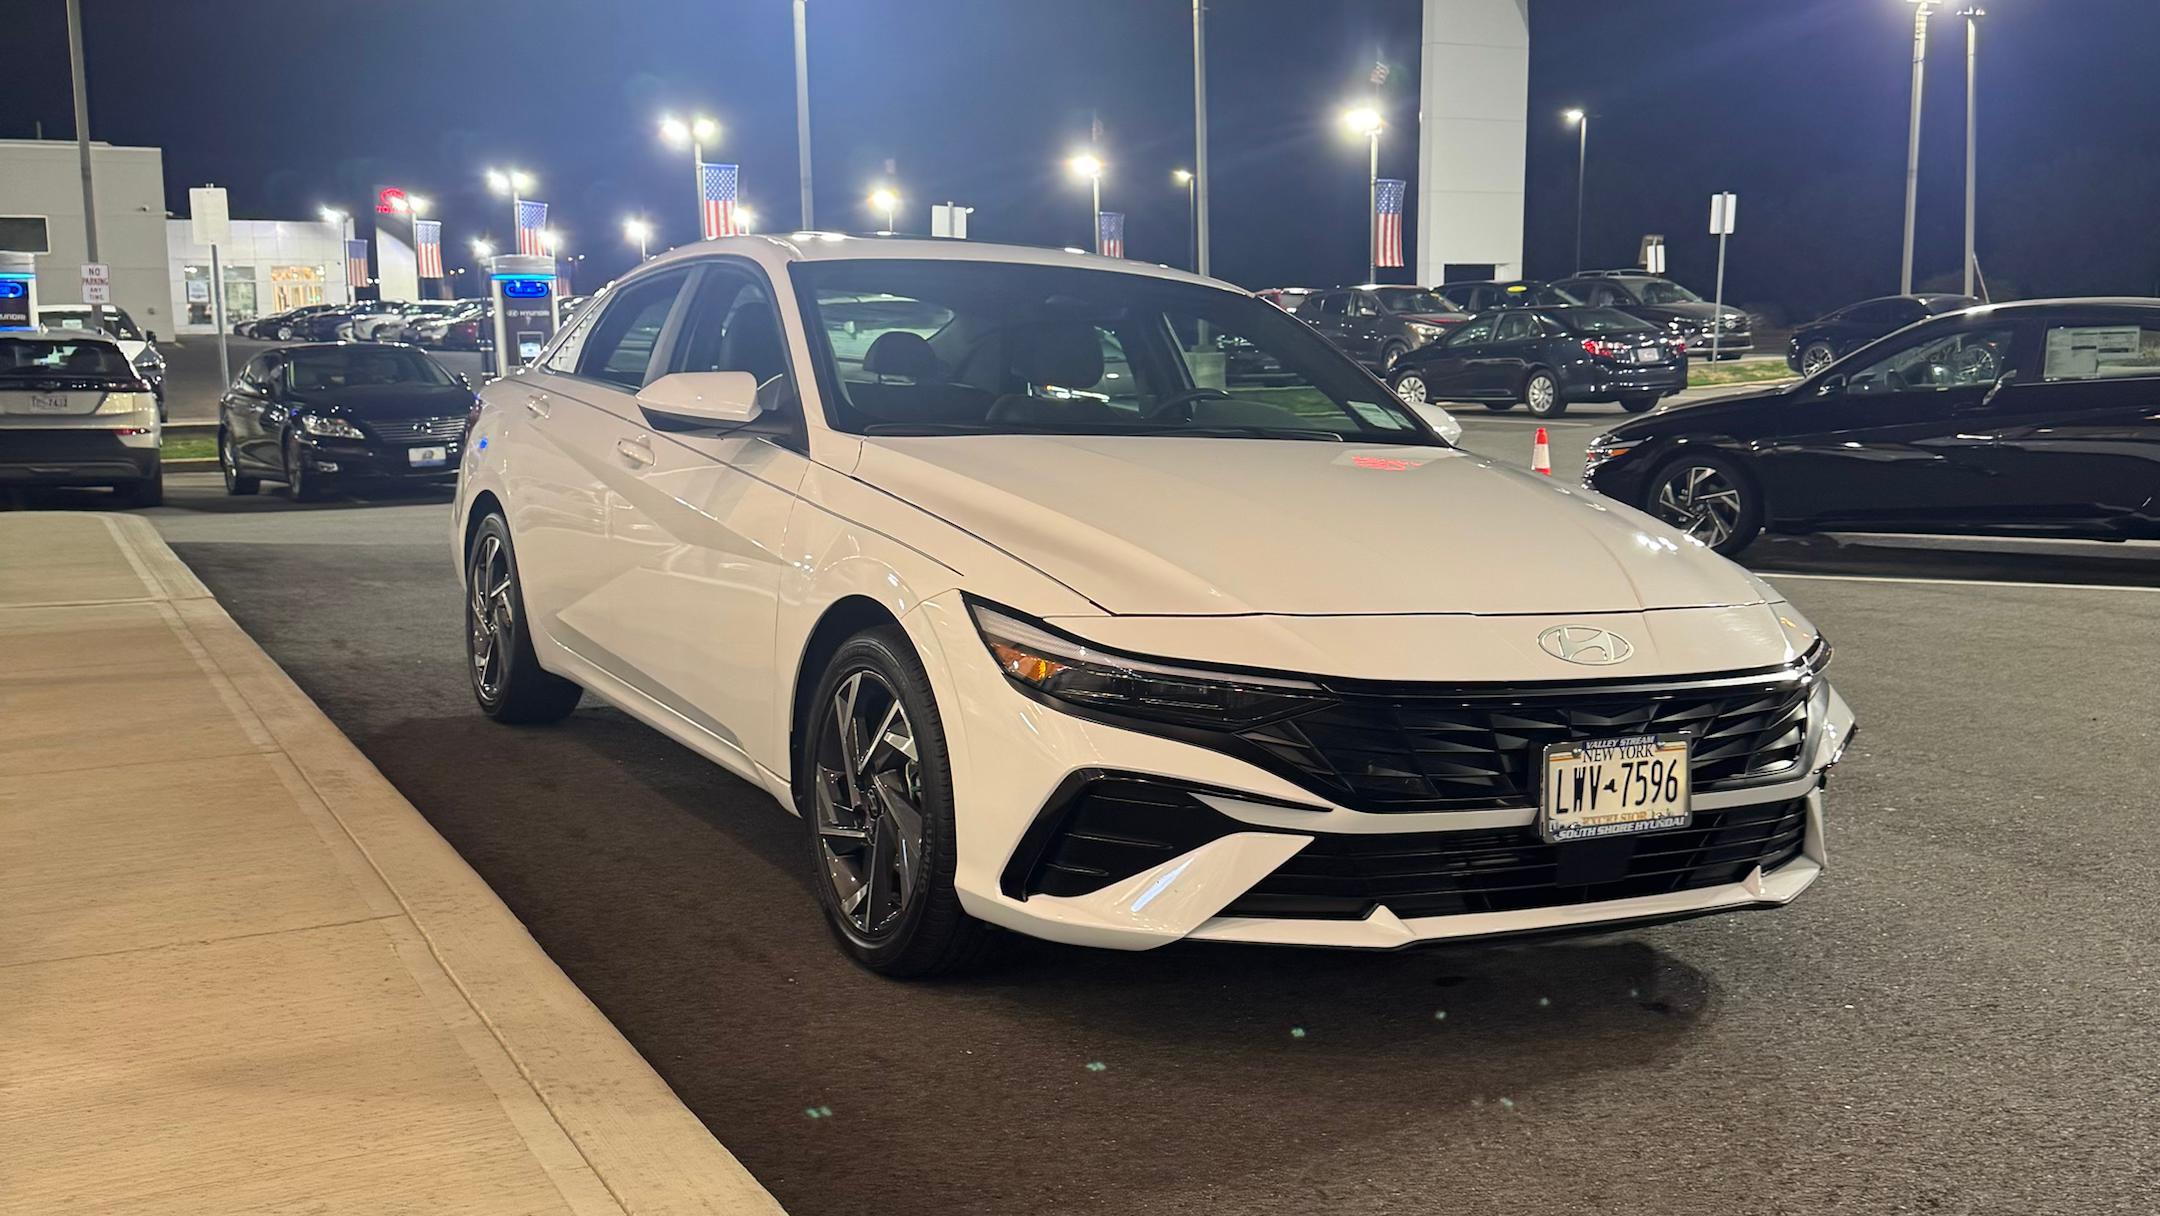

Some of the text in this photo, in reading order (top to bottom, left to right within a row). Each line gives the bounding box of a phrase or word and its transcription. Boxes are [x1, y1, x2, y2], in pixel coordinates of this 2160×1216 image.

[88, 267, 101, 276] NO
[1586, 736, 1656, 749] VALLEY STREAM
[1583, 744, 1654, 763] NEW YORK
[1621, 759, 1678, 807] 7596
[1559, 827, 1597, 839] SOUTH
[1597, 822, 1635, 835] SHORE
[1635, 817, 1686, 831] HYUNDAI
